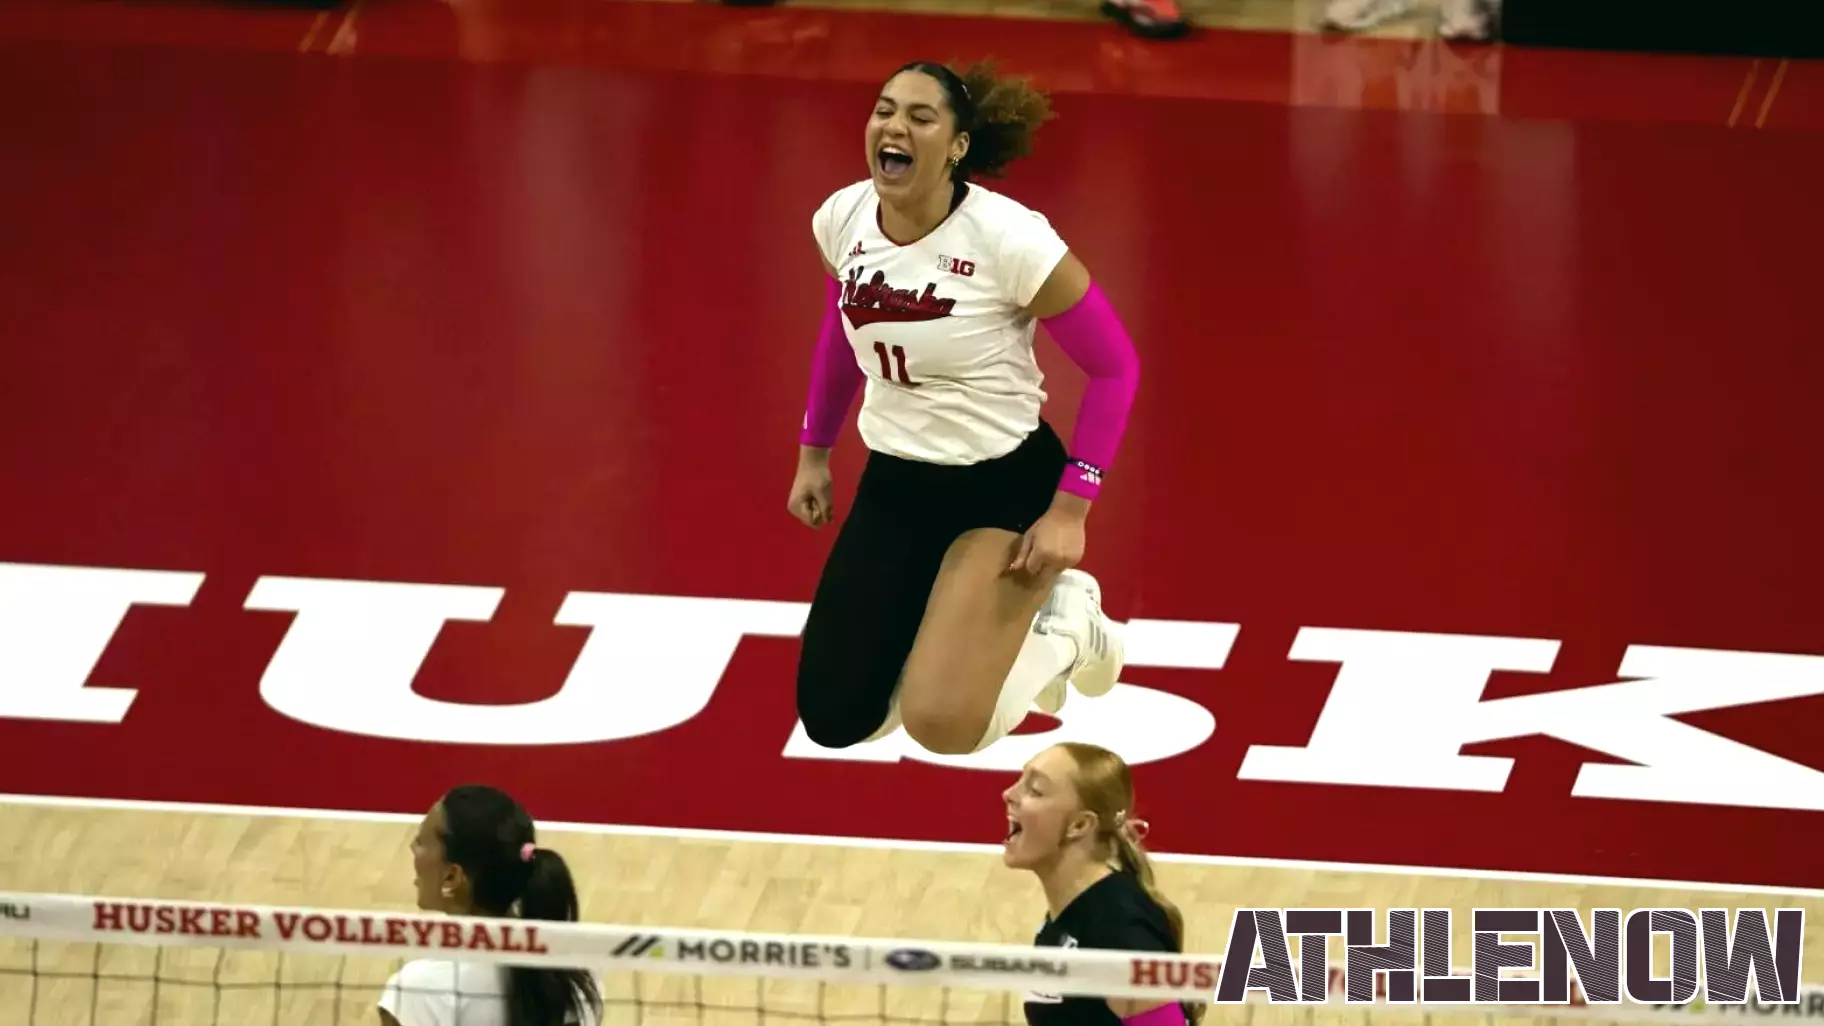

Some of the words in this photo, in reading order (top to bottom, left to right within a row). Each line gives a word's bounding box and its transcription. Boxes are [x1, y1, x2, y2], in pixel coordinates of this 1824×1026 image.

[873, 341, 923, 388] 11
[92, 902, 262, 939] HUSKER
[273, 912, 549, 954] VOLLEYBALL
[677, 938, 852, 968] MORRIE'S
[950, 954, 1070, 977] SUBARU
